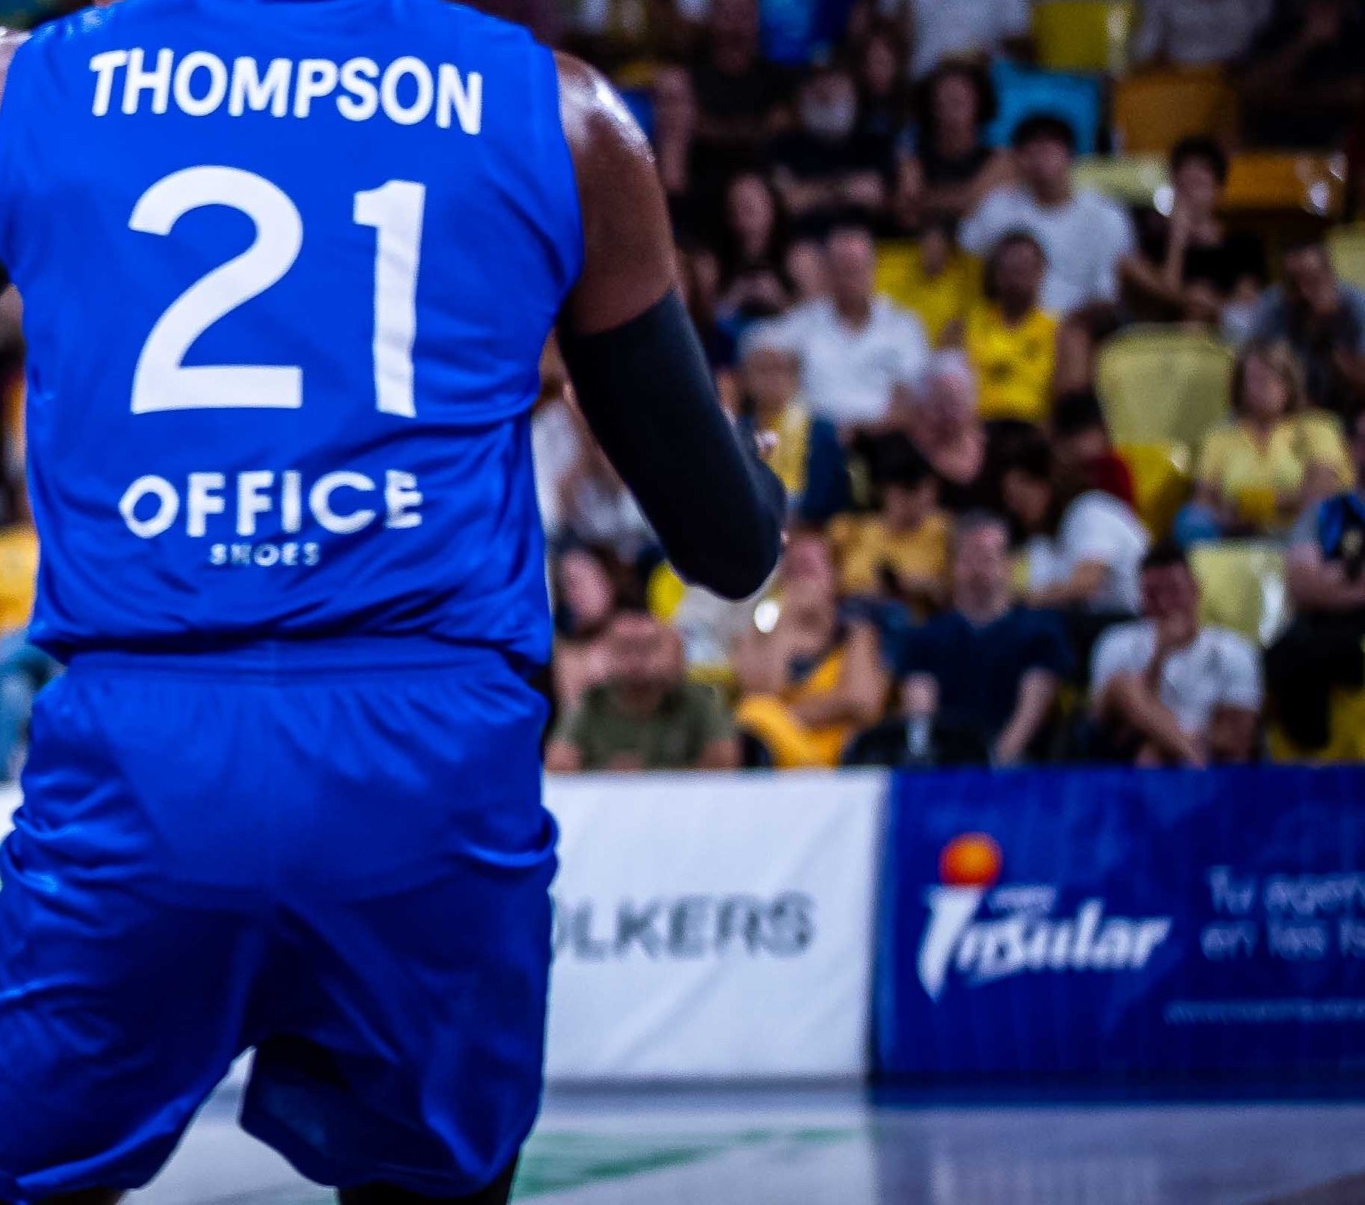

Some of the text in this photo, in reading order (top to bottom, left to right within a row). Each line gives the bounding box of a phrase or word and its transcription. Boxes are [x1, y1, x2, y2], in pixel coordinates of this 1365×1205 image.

[89, 48, 482, 135] THOMPSON
[128, 165, 426, 418] 21
[119, 470, 423, 539] OFFICE
[209, 542, 321, 567] SHOES
